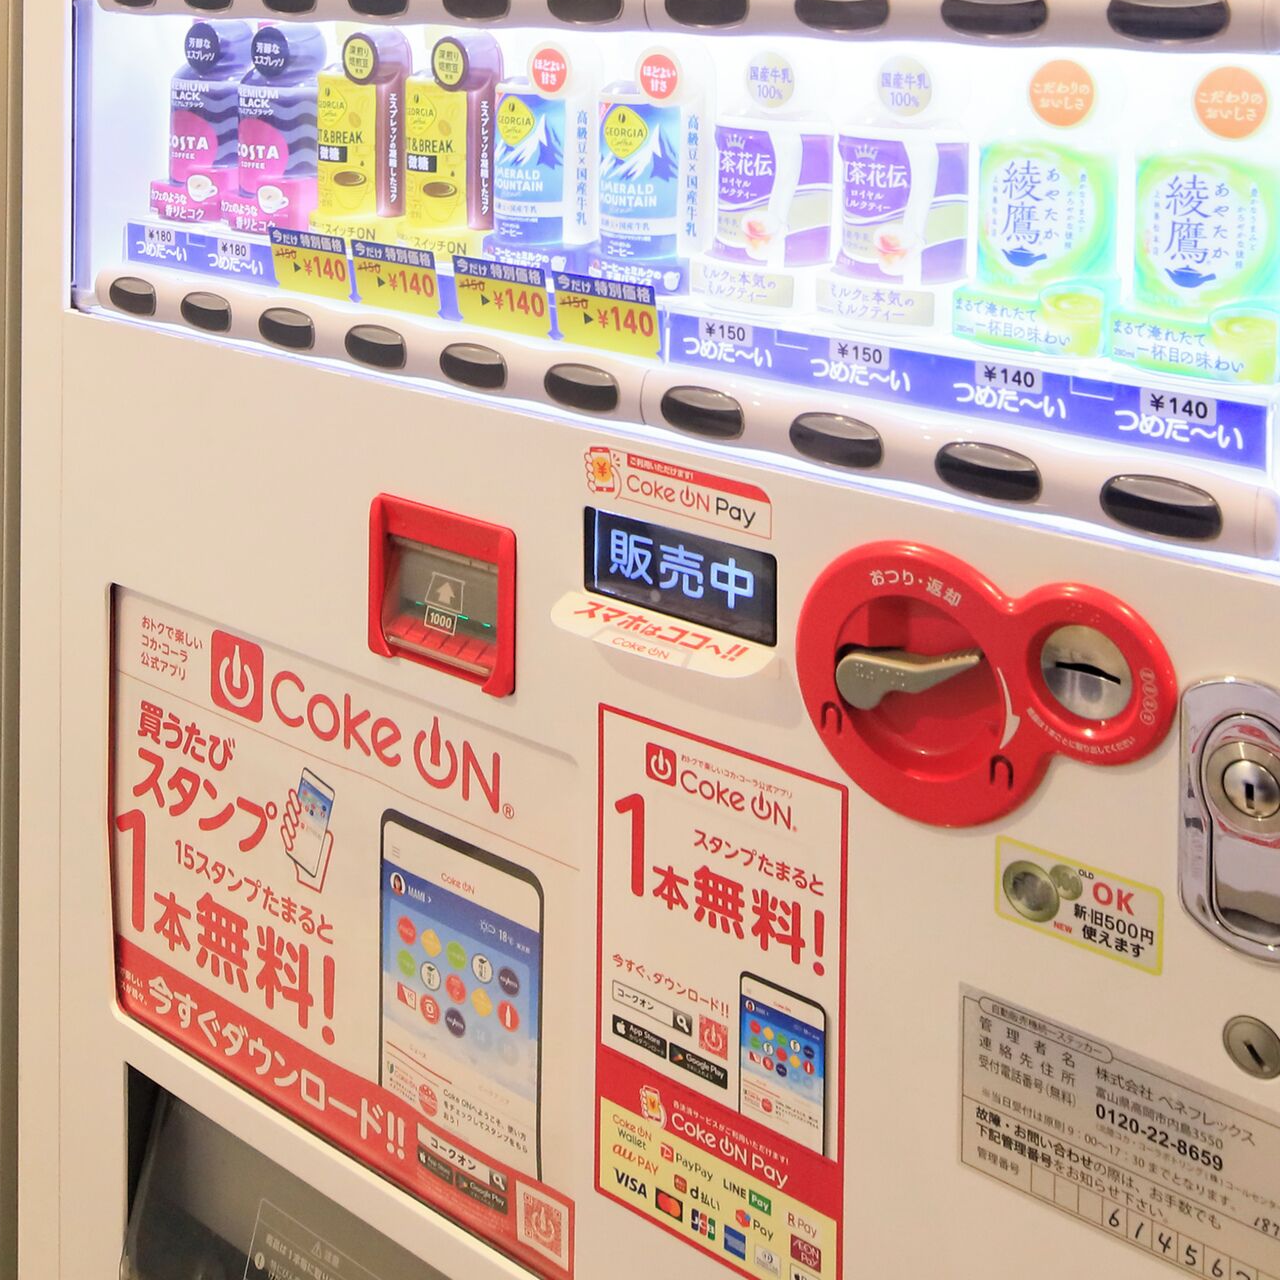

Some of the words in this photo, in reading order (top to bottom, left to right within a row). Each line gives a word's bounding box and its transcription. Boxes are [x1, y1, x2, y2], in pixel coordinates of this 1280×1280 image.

[303, 257, 347, 283] ¥140
[597, 307, 655, 339] ¥140
[705, 321, 746, 342] ¥150
[836, 341, 883, 365] ¥150
[984, 366, 1036, 389] ¥140
[1149, 394, 1209, 420] ¥140
[626, 474, 676, 504] Coke
[715, 496, 757, 529] Pay
[608, 528, 755, 611] 販売中
[429, 611, 453, 630] 1000
[137, 700, 236, 772] 買うたび
[270, 670, 402, 767] Coke
[132, 748, 277, 853] スタンプ
[680, 769, 746, 813] Coke
[693, 828, 825, 897] スタンプたまると
[174, 838, 335, 945] 15スタンプたまると
[1091, 881, 1135, 917] OK
[1082, 923, 1145, 958] 使えます
[671, 1112, 717, 1150] Coke
[751, 1153, 789, 1190] Pay
[1095, 1101, 1224, 1173] 0120-22-8659
